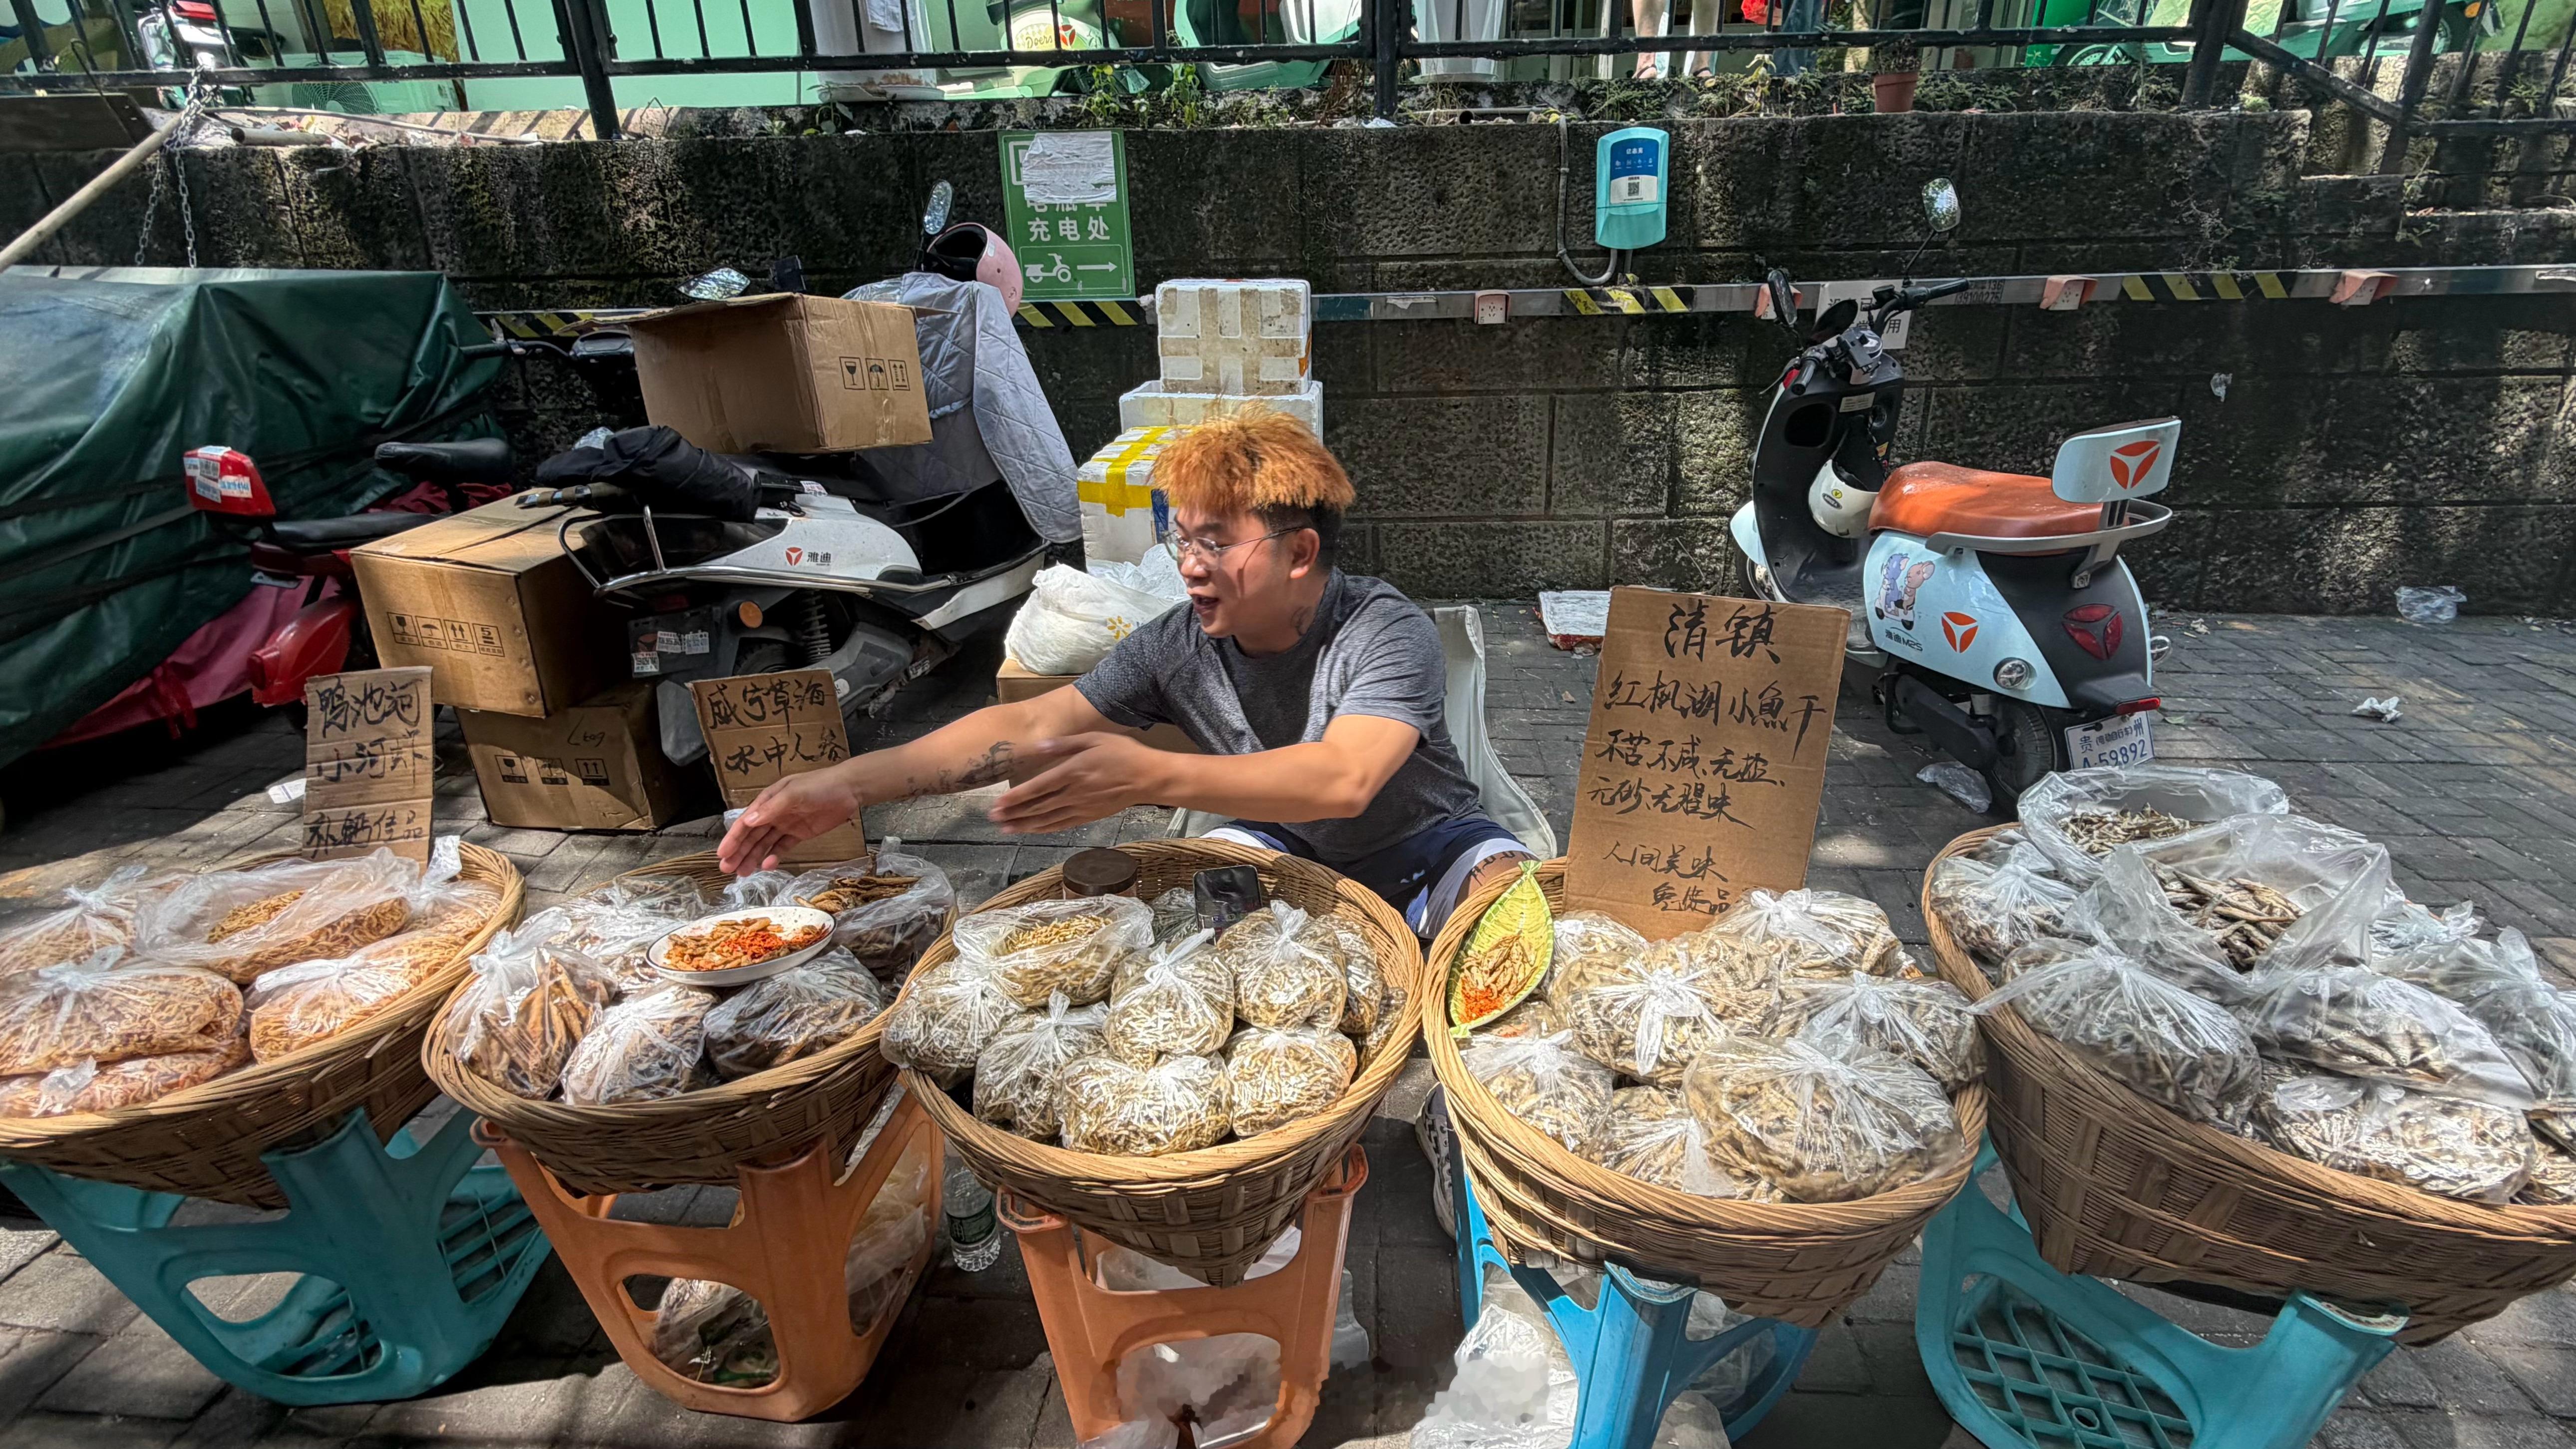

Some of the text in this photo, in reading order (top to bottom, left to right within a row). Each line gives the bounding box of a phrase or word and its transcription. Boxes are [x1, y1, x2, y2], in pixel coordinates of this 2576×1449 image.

[1027, 215, 1110, 242] 充电处
[807, 551, 831, 563] 雅迪
[1664, 599, 1781, 664] 清镇
[316, 676, 423, 739] 鸭池河
[316, 728, 428, 789] 小河虾
[1603, 840, 1729, 883] 人间美味
